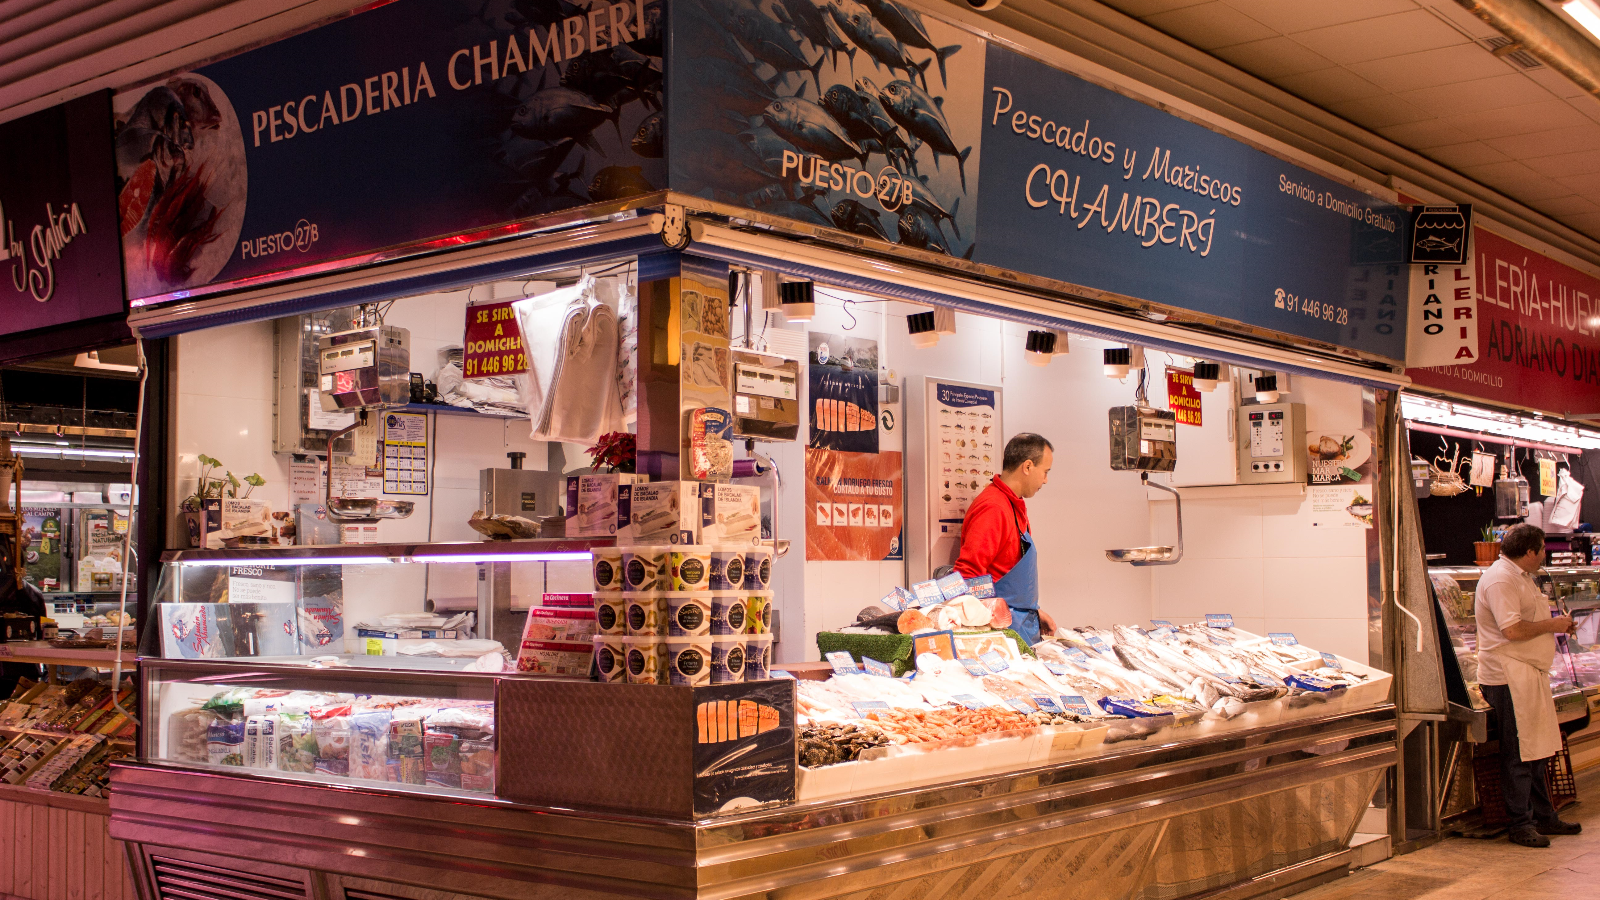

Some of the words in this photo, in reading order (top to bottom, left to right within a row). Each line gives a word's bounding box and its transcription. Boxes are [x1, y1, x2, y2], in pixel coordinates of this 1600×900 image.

[252, 61, 437, 147] PESCADERIA
[992, 86, 1117, 164] Pescados
[1123, 148, 1137, 180] y
[1142, 146, 1242, 207] Mariscos
[781, 149, 876, 199] PUESTO
[1278, 173, 1316, 203] Servicio
[1317, 193, 1324, 206] a
[1325, 192, 1364, 221] Domicilio
[1364, 208, 1396, 233] Gratuito
[9, 220, 28, 292] by
[241, 231, 295, 260] PUESTO
[1286, 293, 1299, 313] 91
[1301, 298, 1320, 319] 446
[1322, 303, 1334, 322] 96
[1336, 307, 1348, 326] 28
[1423, 264, 1444, 336] RIANO
[476, 310, 489, 323] SE
[491, 307, 515, 321] SIRV
[1453, 268, 1475, 360] LERIA
[494, 323, 504, 336] A
[1487, 316, 1567, 378] ADRIANO
[466, 358, 478, 376] 91
[480, 355, 500, 374] 446
[502, 354, 515, 372] 96
[1172, 373, 1179, 383] SE
[1179, 374, 1194, 386] SIRV
[1453, 367, 1460, 379] A
[1462, 368, 1503, 388] DOMICILIO
[942, 389, 950, 402] 30
[1182, 385, 1187, 396] A
[1169, 394, 1201, 409] DOMICILIO
[1177, 408, 1187, 423] 446
[1194, 411, 1202, 425] 28
[843, 478, 872, 488] NORUEGO
[872, 479, 893, 488] FRESCO
[1312, 474, 1342, 482] MARCA
[833, 484, 860, 494] CORTALO
[860, 486, 865, 495] A
[866, 486, 873, 495] TU
[874, 486, 893, 496] GUSTO
[232, 566, 263, 577] FRESCO
